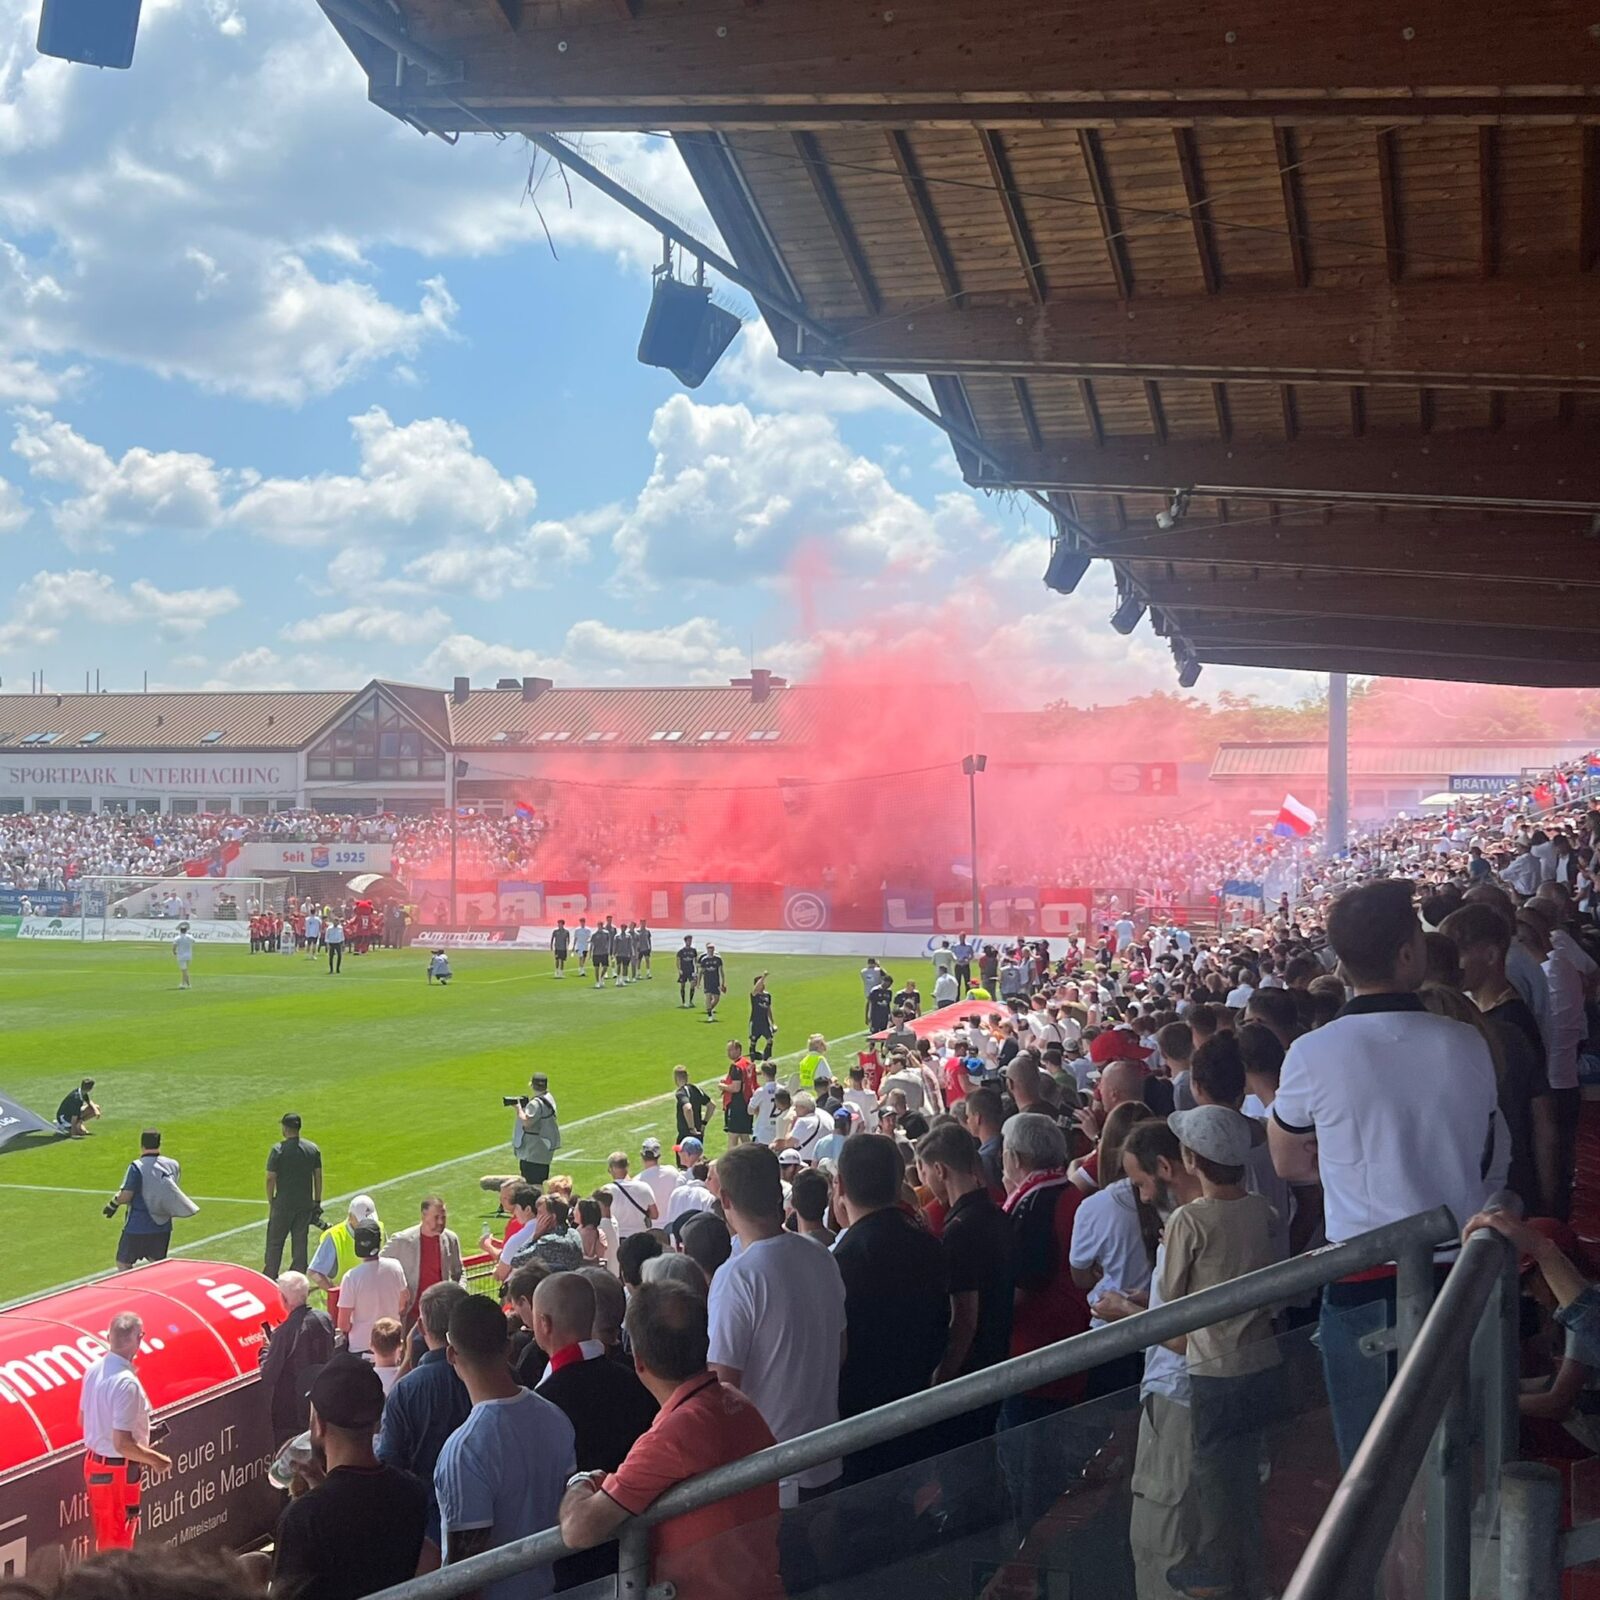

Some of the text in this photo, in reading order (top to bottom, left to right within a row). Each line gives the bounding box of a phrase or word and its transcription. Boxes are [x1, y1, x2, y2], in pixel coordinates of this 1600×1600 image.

[10, 767, 281, 785] SPORTPARK UNTERHACHING
[282, 851, 366, 863] Seit 1925
[20, 925, 81, 938] Alpenbauer
[60, 1425, 239, 1528] Mit äuft eure IT.
[148, 1490, 185, 1530] läuft
[190, 1480, 216, 1510] die
[180, 1508, 228, 1545] Mittelstand
